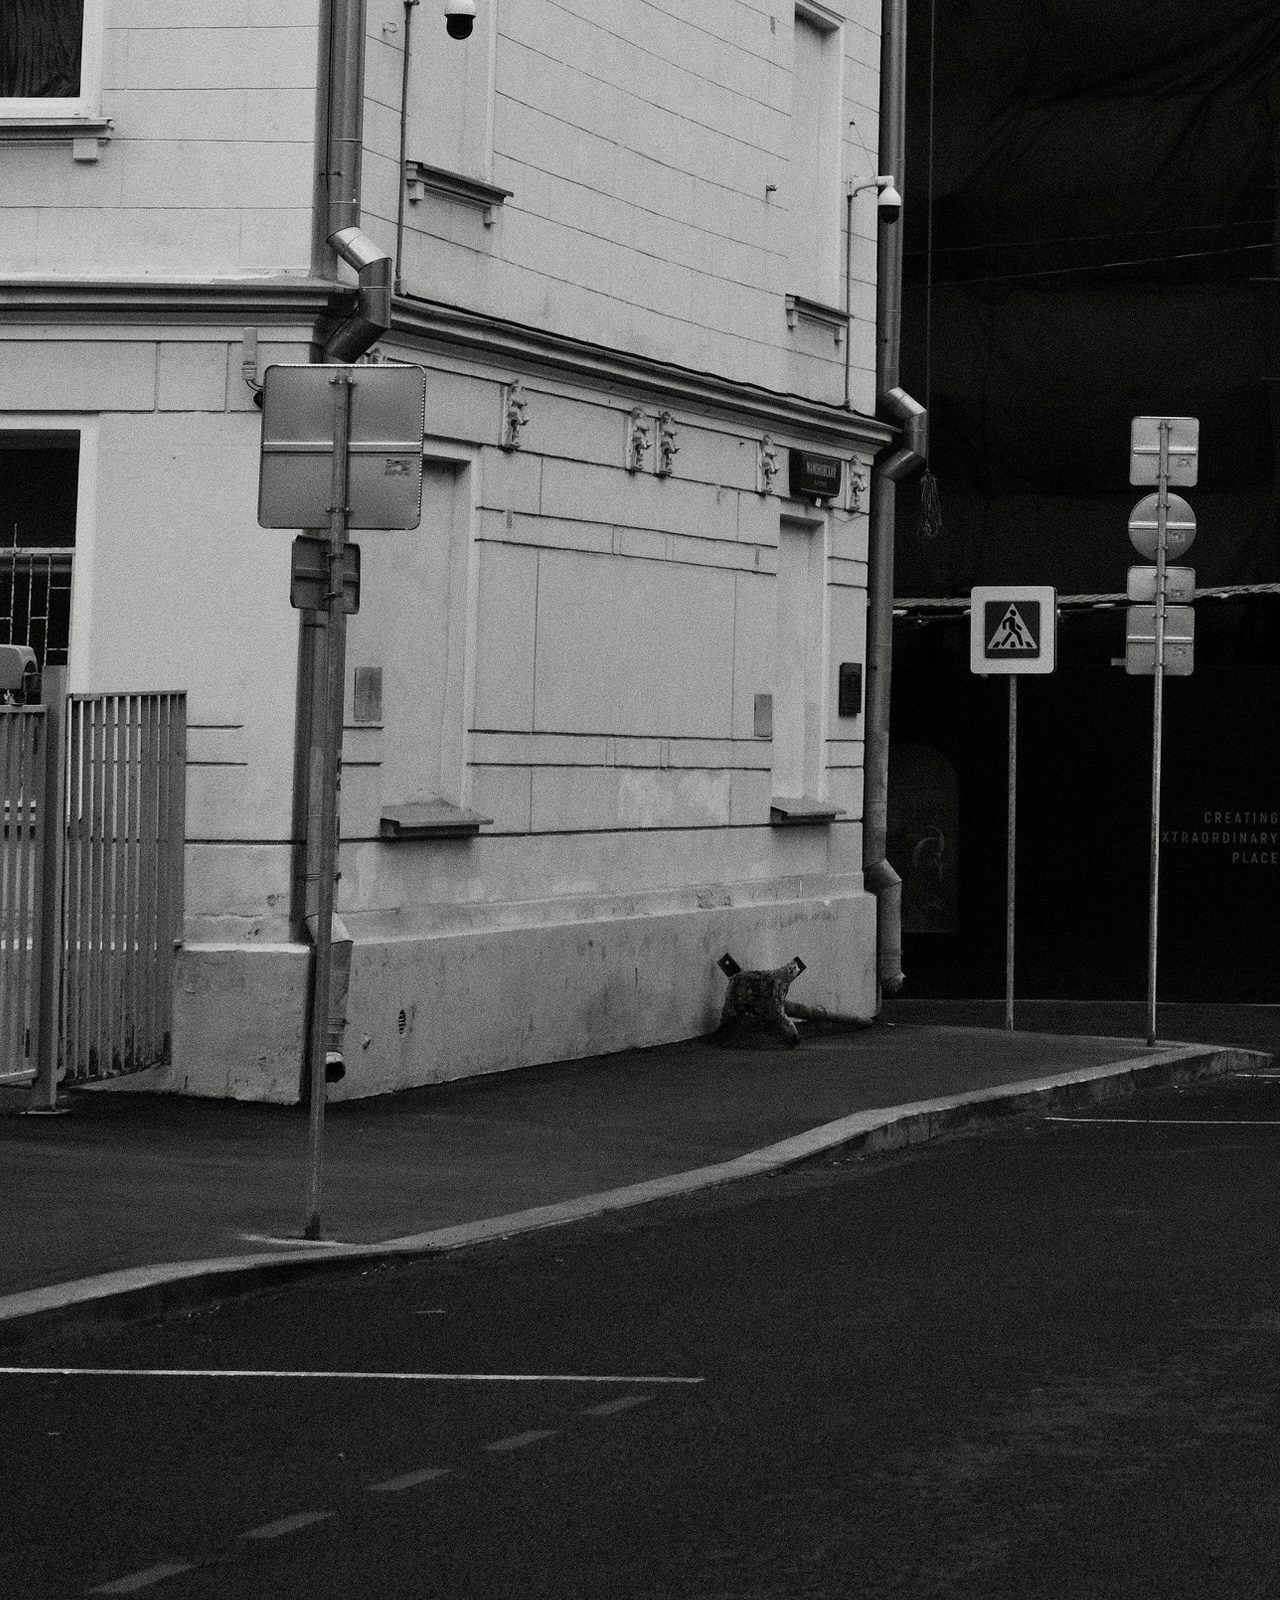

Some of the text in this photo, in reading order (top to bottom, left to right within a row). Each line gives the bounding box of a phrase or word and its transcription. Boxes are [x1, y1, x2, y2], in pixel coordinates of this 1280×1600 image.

[1204, 810, 1279, 825] CREATING
[1154, 830, 1278, 845] XTRAORDINARY
[1232, 851, 1278, 865] PLACE
